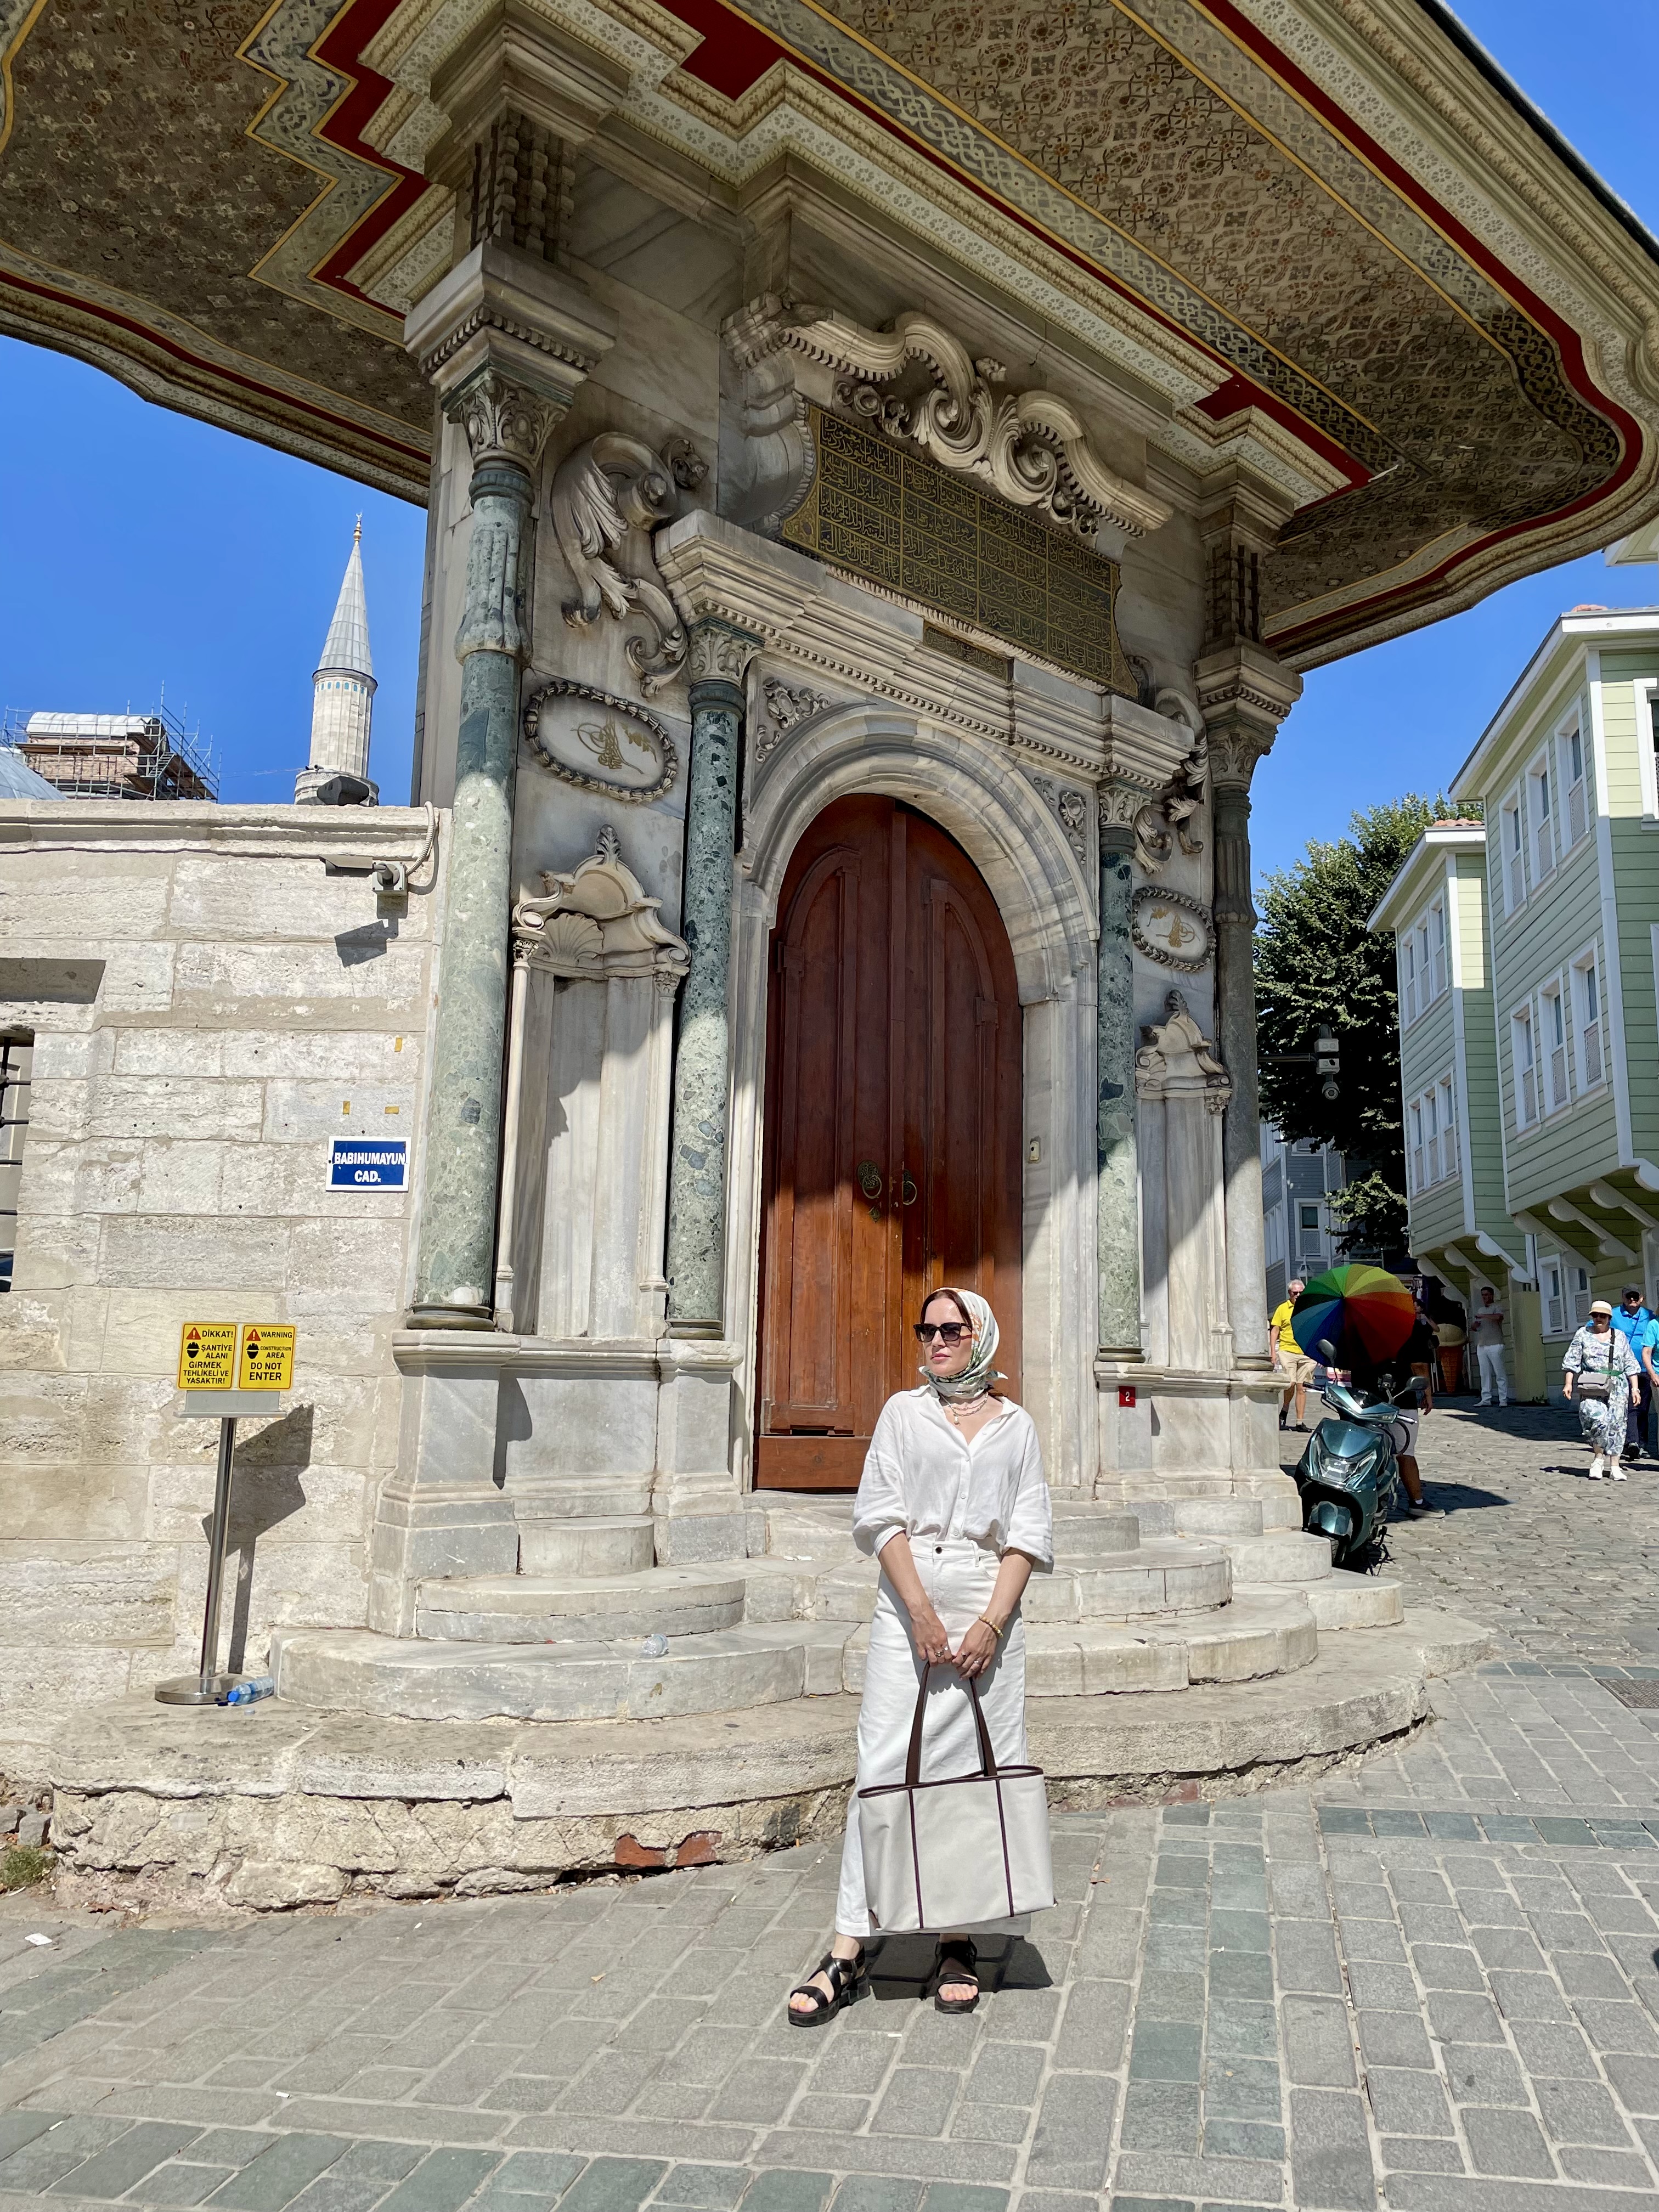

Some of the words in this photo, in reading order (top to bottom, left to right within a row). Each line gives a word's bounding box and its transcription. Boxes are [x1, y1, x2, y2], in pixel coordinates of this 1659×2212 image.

[335, 1152, 405, 1165] BABIHUMAYUN
[354, 1170, 381, 1182] CAD.
[202, 1329, 233, 1338] DİKKAT!
[201, 1344, 233, 1352] ŞANTİYE
[249, 1372, 281, 1380] ENTER
[1125, 1391, 1130, 1402] 2
